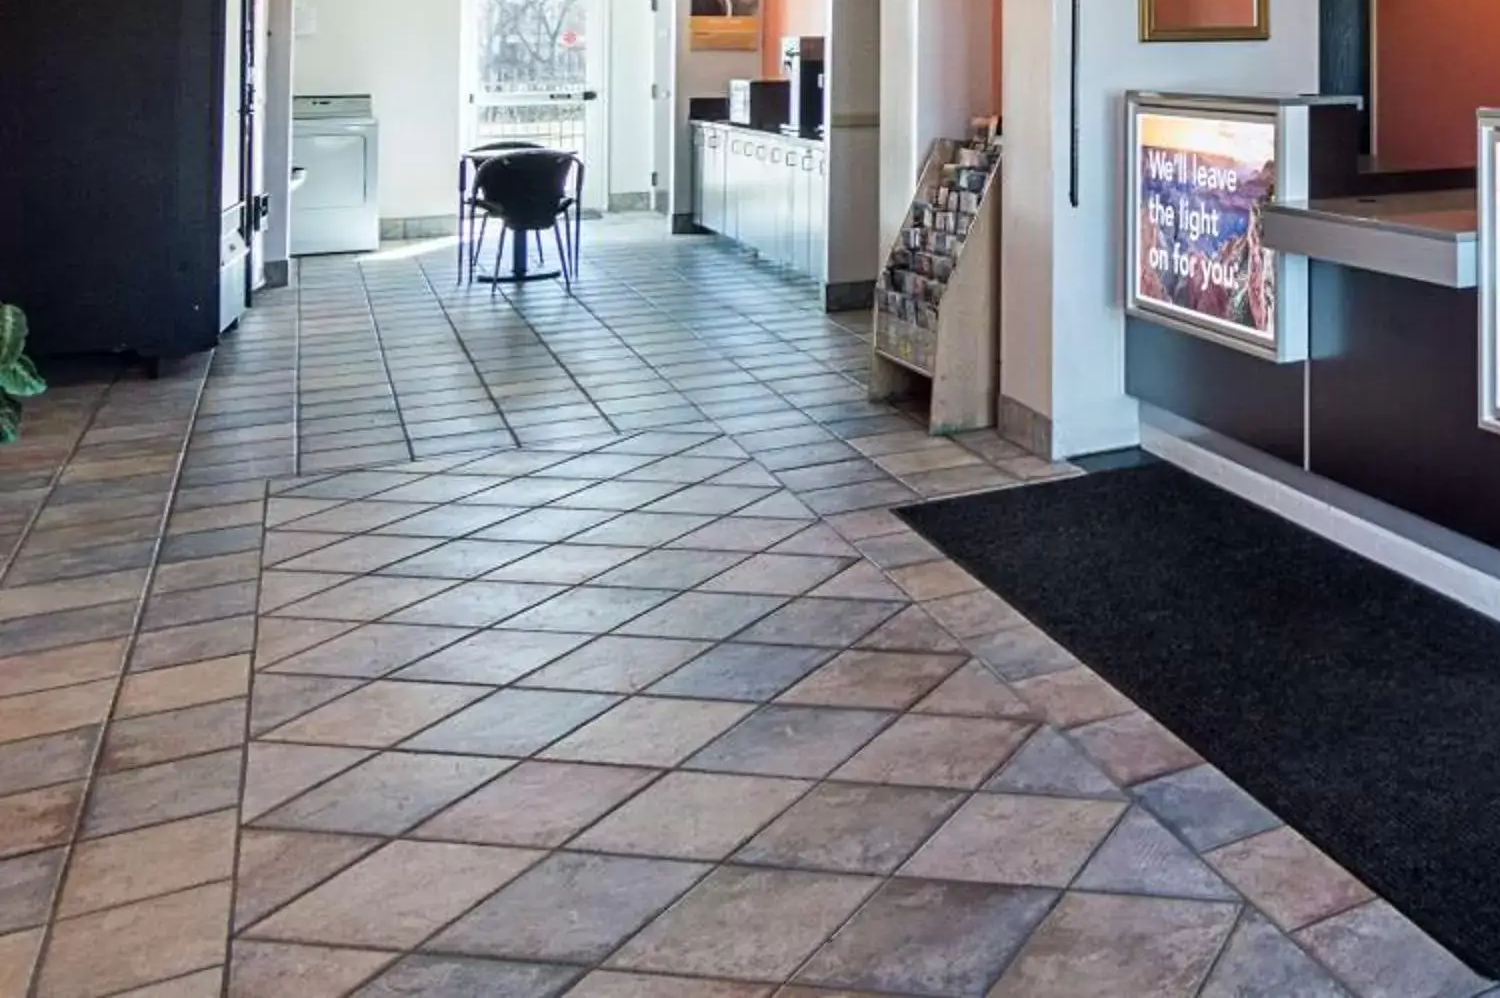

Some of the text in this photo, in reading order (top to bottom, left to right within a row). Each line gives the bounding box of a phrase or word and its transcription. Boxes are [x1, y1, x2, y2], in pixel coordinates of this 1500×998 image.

[1148, 149, 1237, 192] We'll leave
[1148, 193, 1220, 241] the light
[1149, 246, 1169, 271] on
[1173, 241, 1198, 278] for
